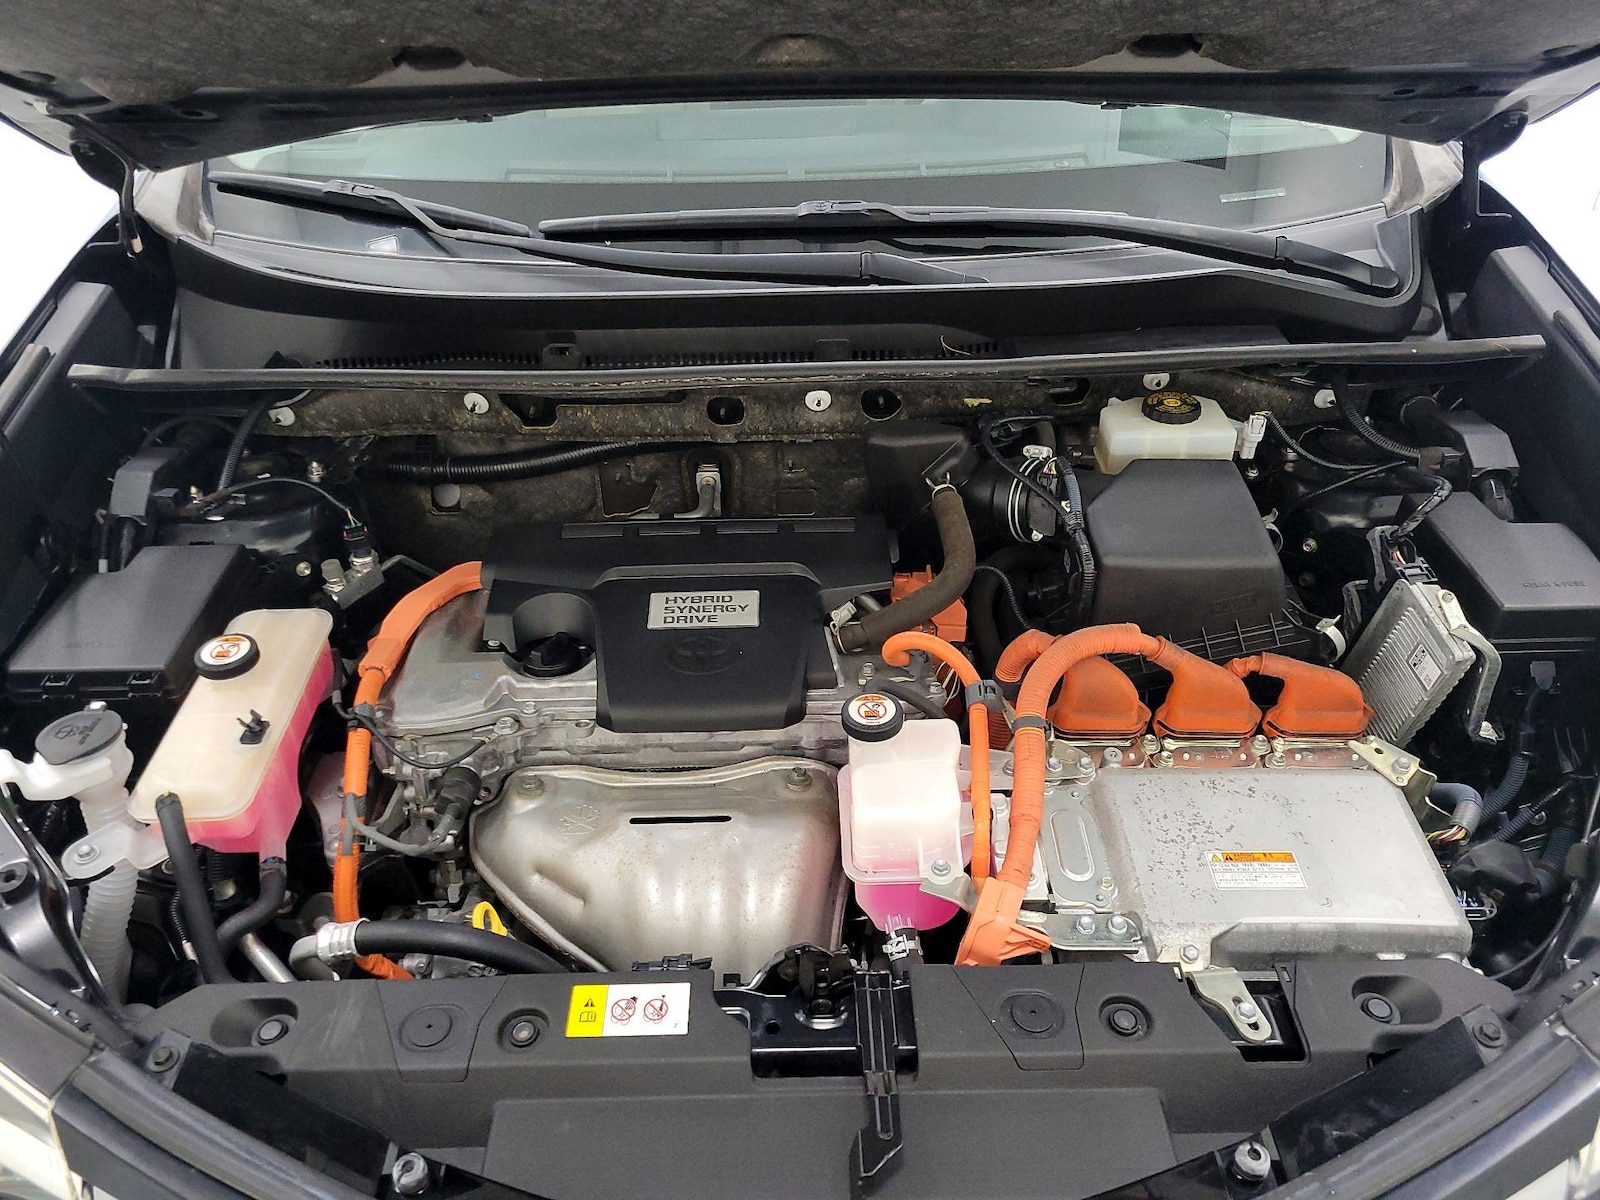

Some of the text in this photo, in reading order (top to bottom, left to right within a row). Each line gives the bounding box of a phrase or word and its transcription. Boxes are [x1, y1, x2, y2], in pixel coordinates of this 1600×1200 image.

[664, 595, 733, 605] HYBRID
[663, 604, 750, 615] SYNERGY
[663, 614, 719, 624] DRIVE
